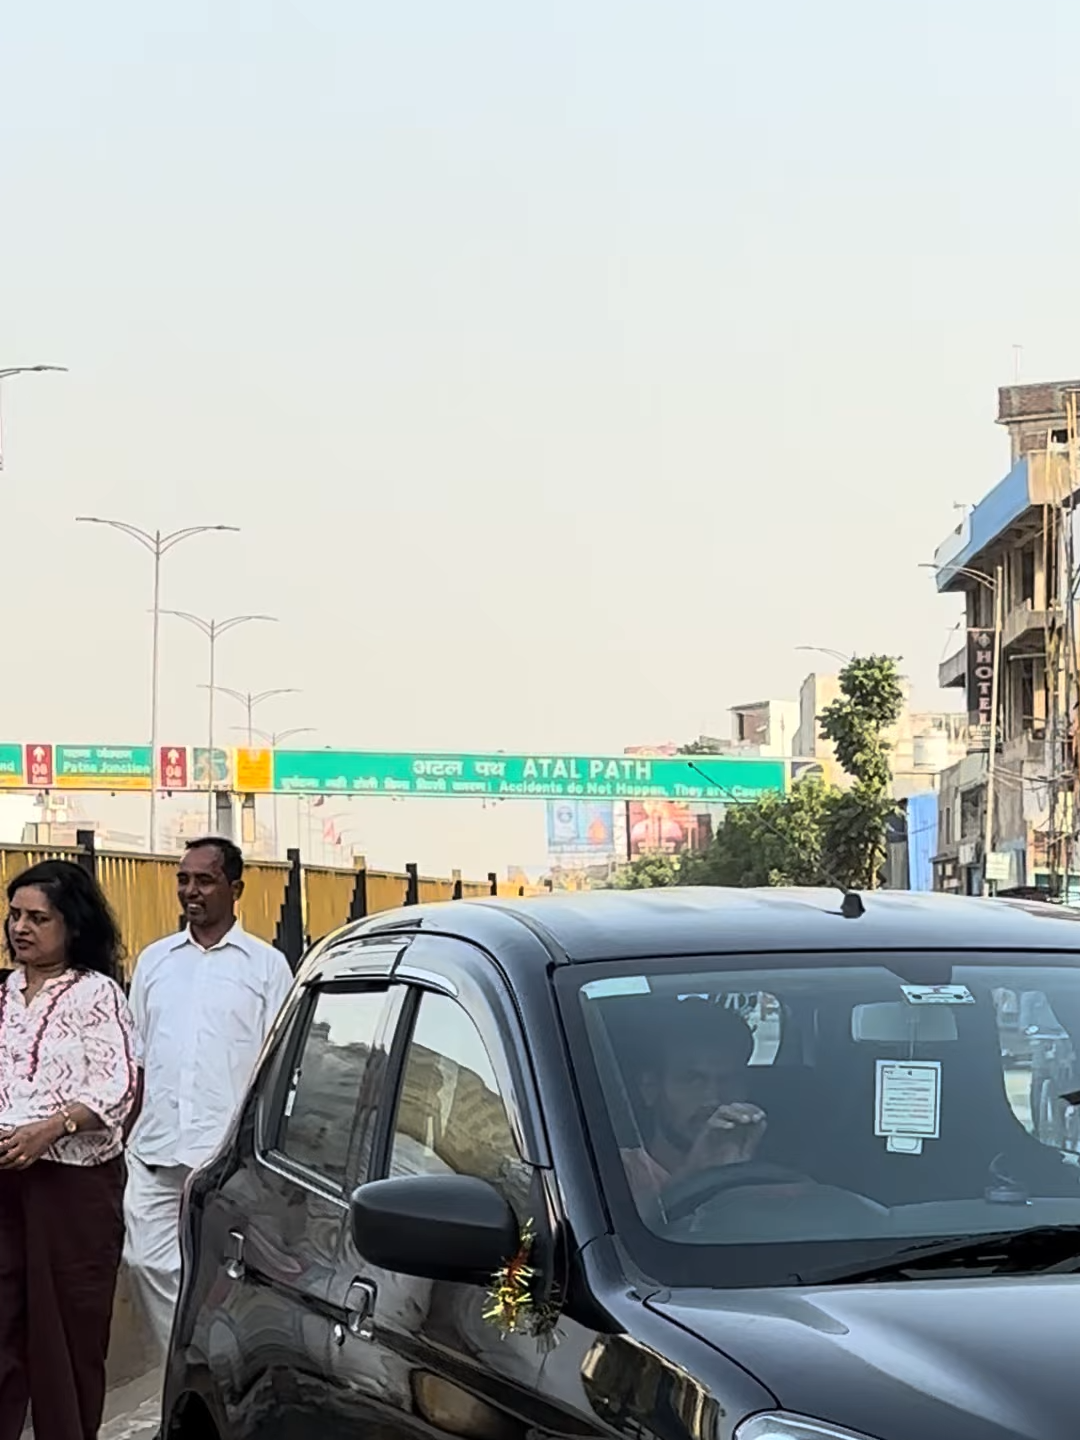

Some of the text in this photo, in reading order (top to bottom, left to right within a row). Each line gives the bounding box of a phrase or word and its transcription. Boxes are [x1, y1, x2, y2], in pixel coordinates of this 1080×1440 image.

[975, 651, 993, 725] HOTEL
[413, 759, 506, 777] अटल पथ
[522, 758, 651, 781] ATAL PATH
[499, 781, 563, 794] Accidents
[566, 782, 583, 795] do
[587, 782, 613, 796] Not
[673, 783, 704, 798] They
